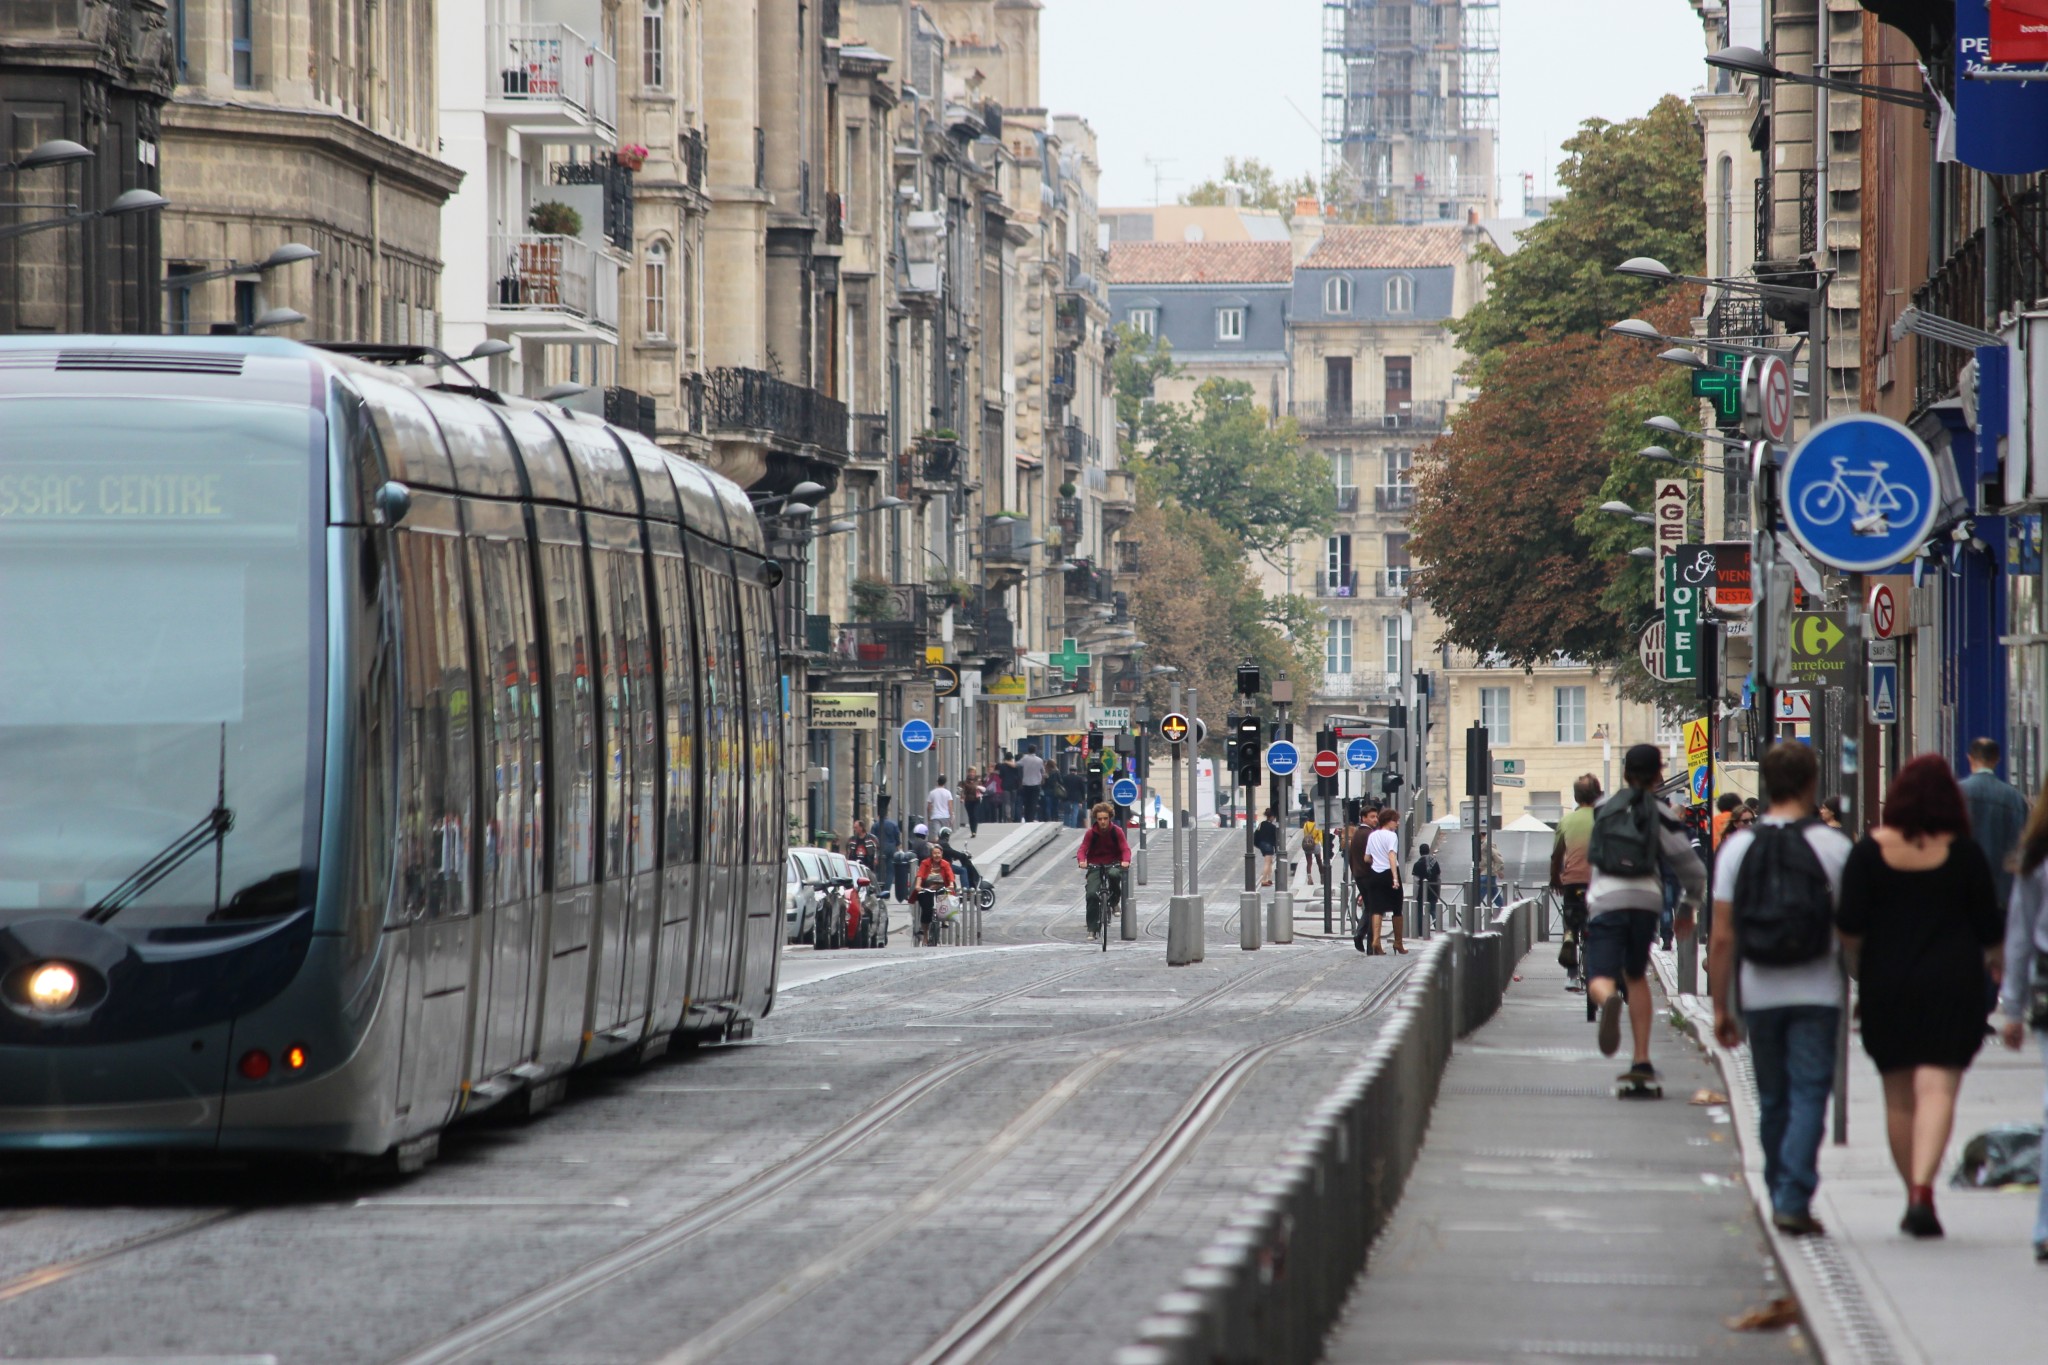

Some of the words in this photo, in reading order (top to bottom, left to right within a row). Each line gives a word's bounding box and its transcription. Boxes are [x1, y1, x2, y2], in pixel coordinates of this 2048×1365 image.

[2020, 23, 2048, 33] borde
[1961, 37, 1989, 53] PE
[99, 474, 222, 515] CENTRE
[1717, 569, 1752, 582] VIENN
[1717, 591, 1752, 601] RESTA
[1791, 658, 1846, 671] arrefour
[813, 707, 877, 718] Fraternelle
[1104, 709, 1129, 718] MARC
